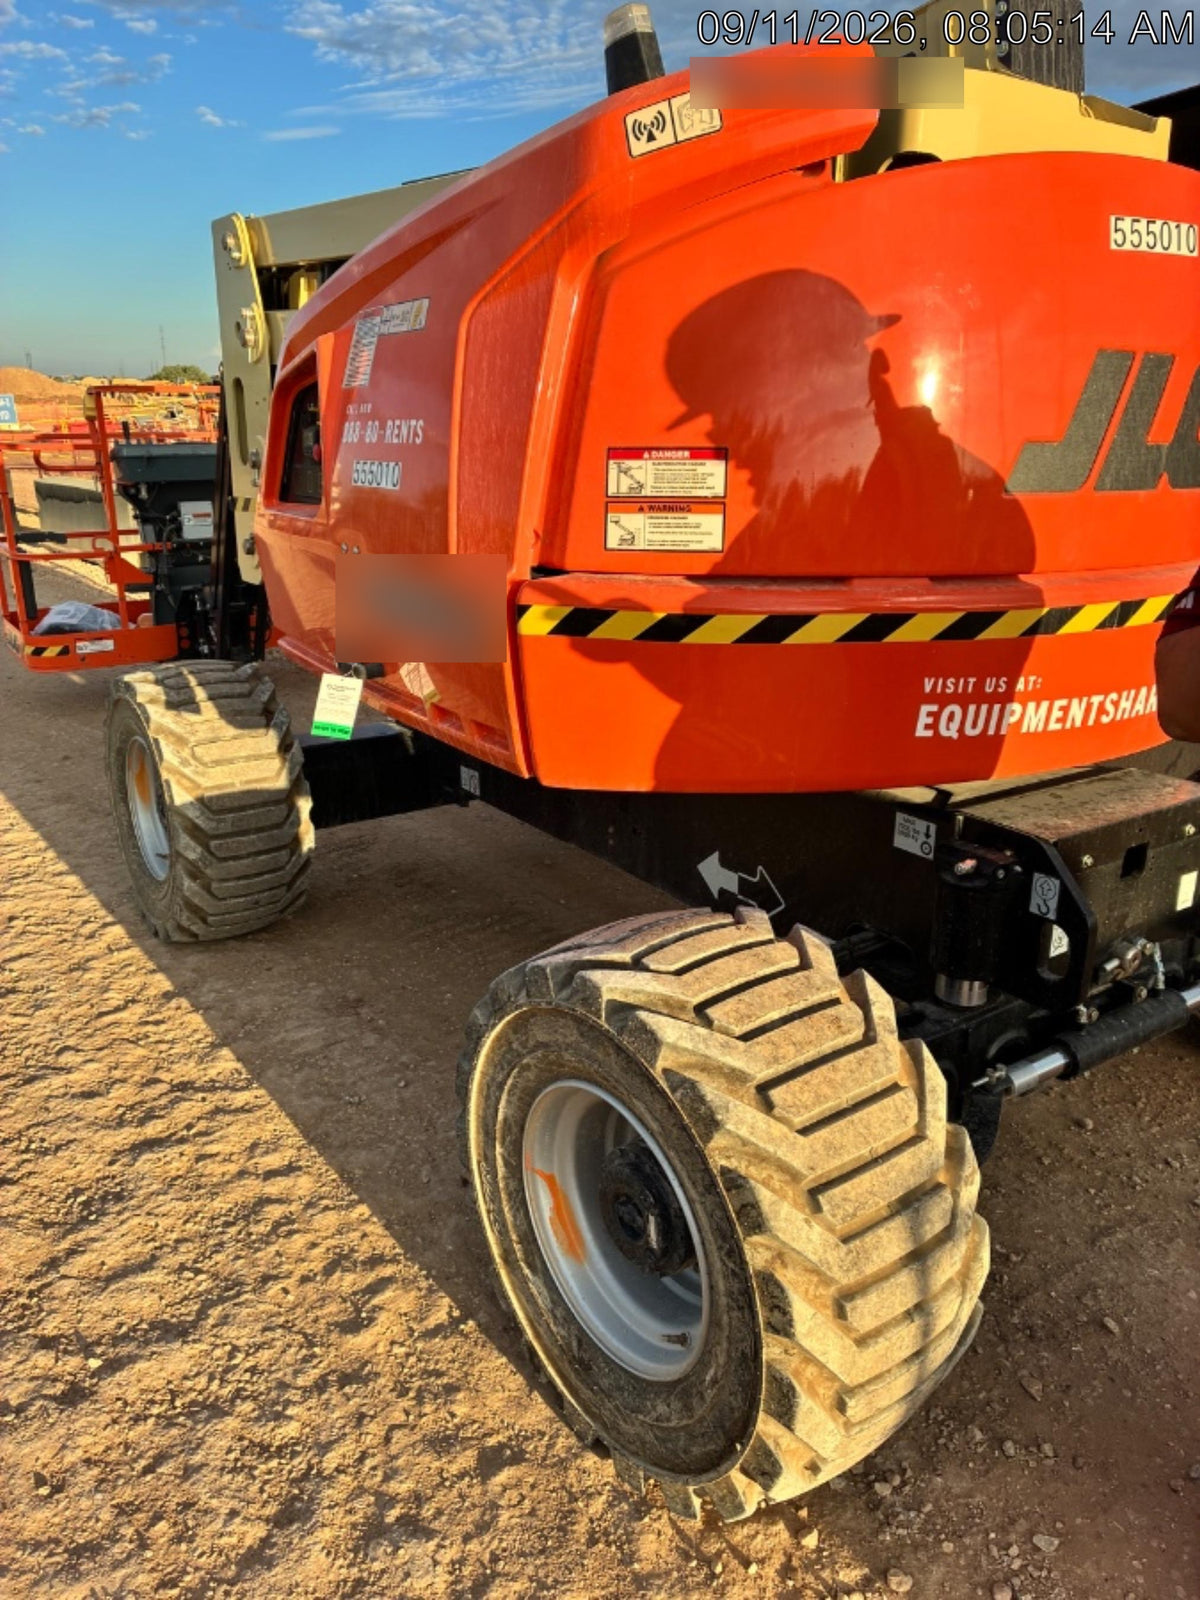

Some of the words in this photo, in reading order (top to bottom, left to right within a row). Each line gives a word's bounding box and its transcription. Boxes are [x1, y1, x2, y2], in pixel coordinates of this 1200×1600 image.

[1113, 217, 1196, 254] 555010
[353, 461, 400, 487] 555010
[923, 677, 977, 693] VISIT
[984, 677, 1008, 693] US
[1015, 675, 1043, 692] AT:
